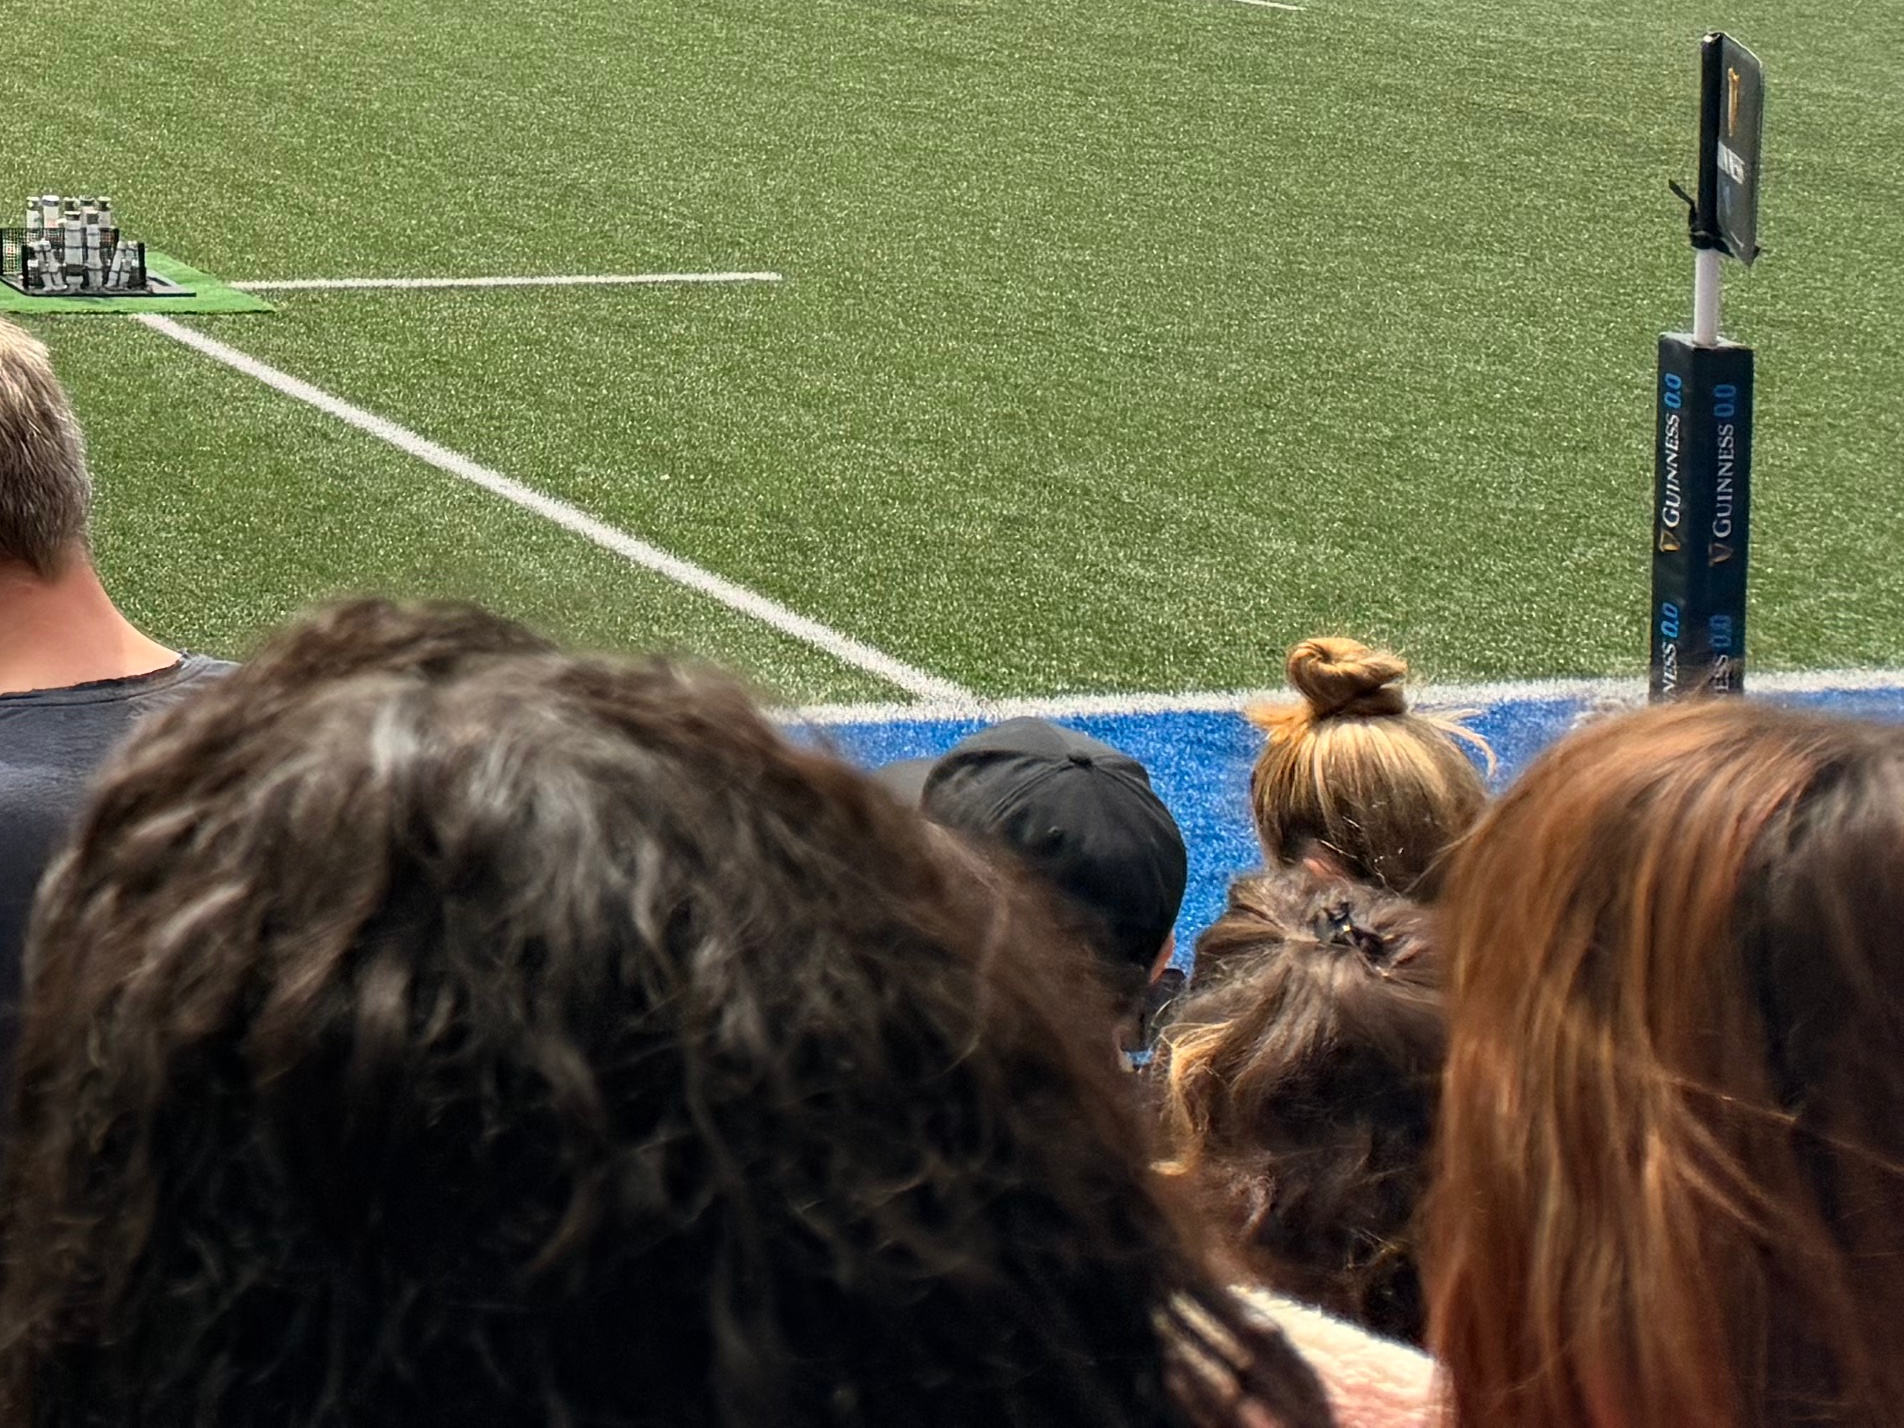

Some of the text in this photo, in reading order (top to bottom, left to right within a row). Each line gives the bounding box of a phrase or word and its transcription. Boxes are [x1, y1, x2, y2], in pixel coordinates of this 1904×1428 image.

[1660, 373, 1683, 527] GUINNESS 0.0
[1711, 383, 1737, 538] GUINNESS 0.0
[1662, 602, 1680, 638] 0.0
[1707, 615, 1731, 649] 0.0
